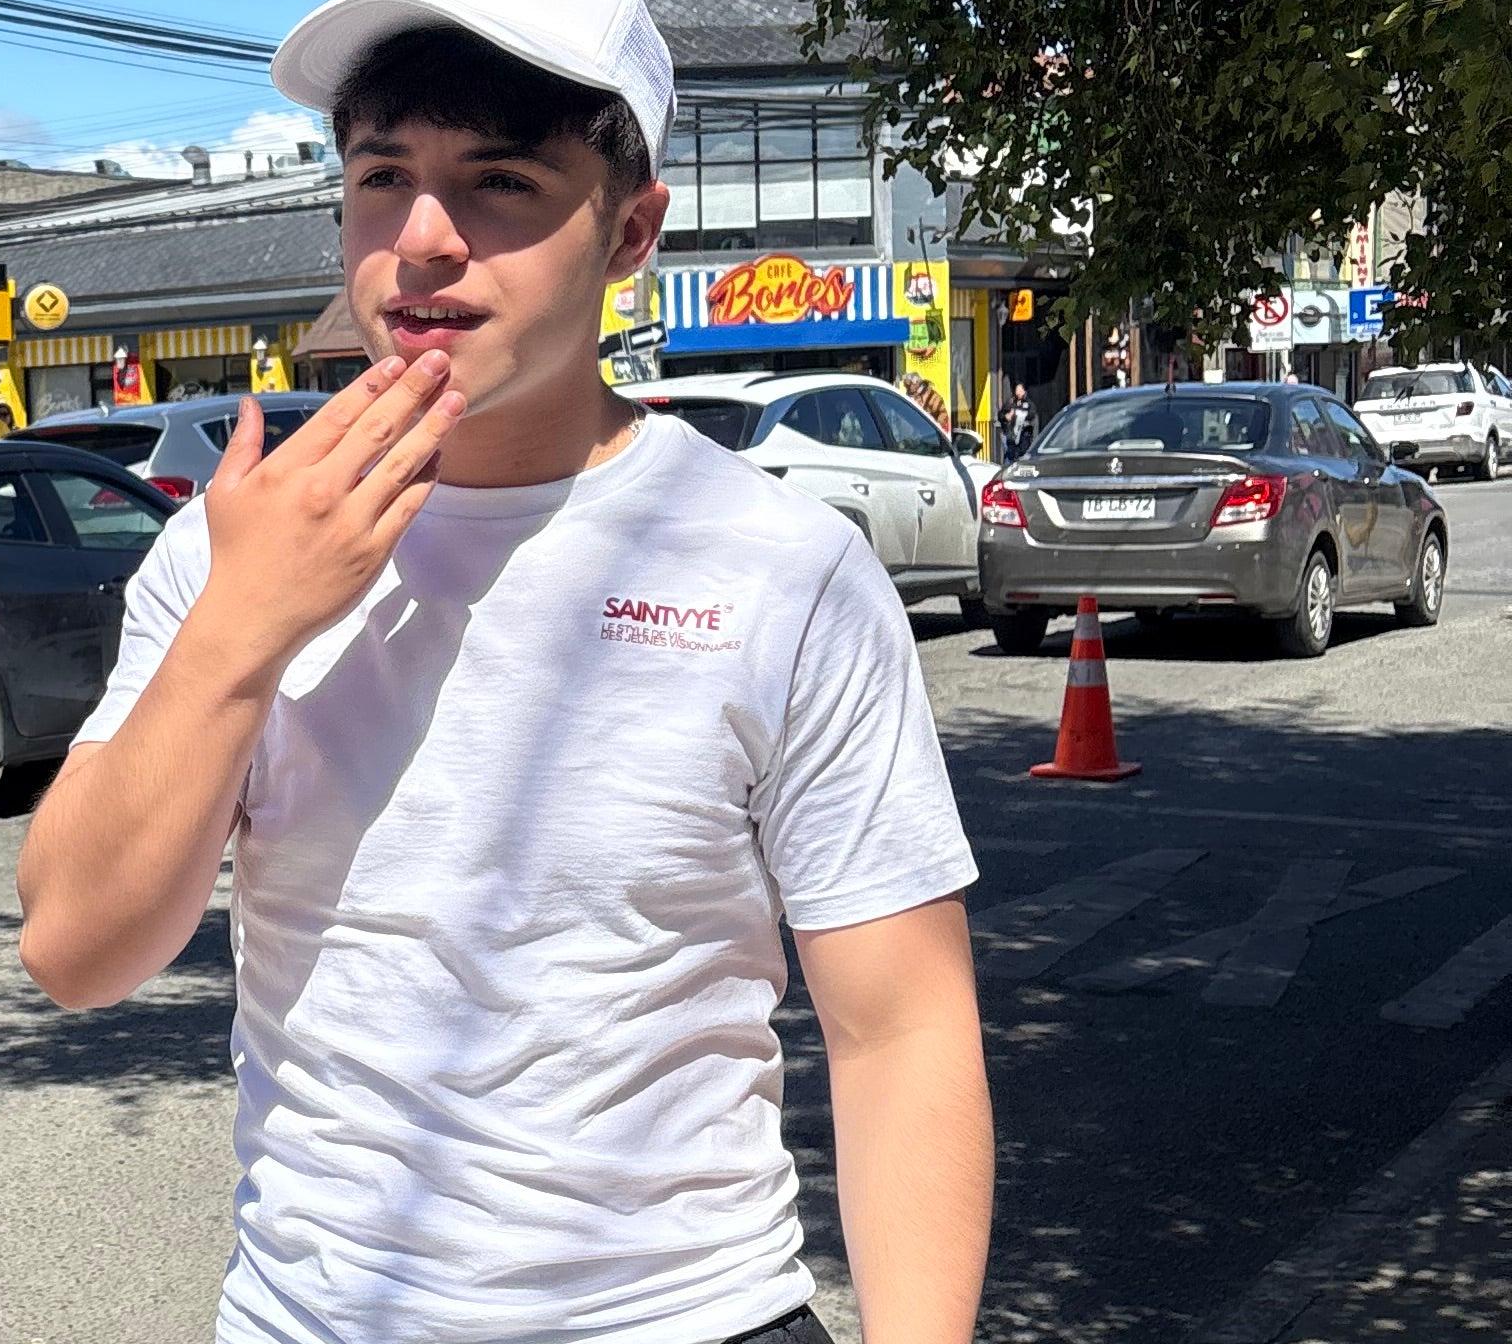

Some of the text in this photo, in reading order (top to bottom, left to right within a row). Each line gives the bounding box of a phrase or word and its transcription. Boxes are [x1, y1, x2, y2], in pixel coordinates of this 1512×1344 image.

[603, 597, 721, 631] SAINTVYÉ
[600, 629, 622, 642] DES
[624, 633, 668, 648] JEUNES
[602, 622, 685, 641] LE STYLE DE VIE
